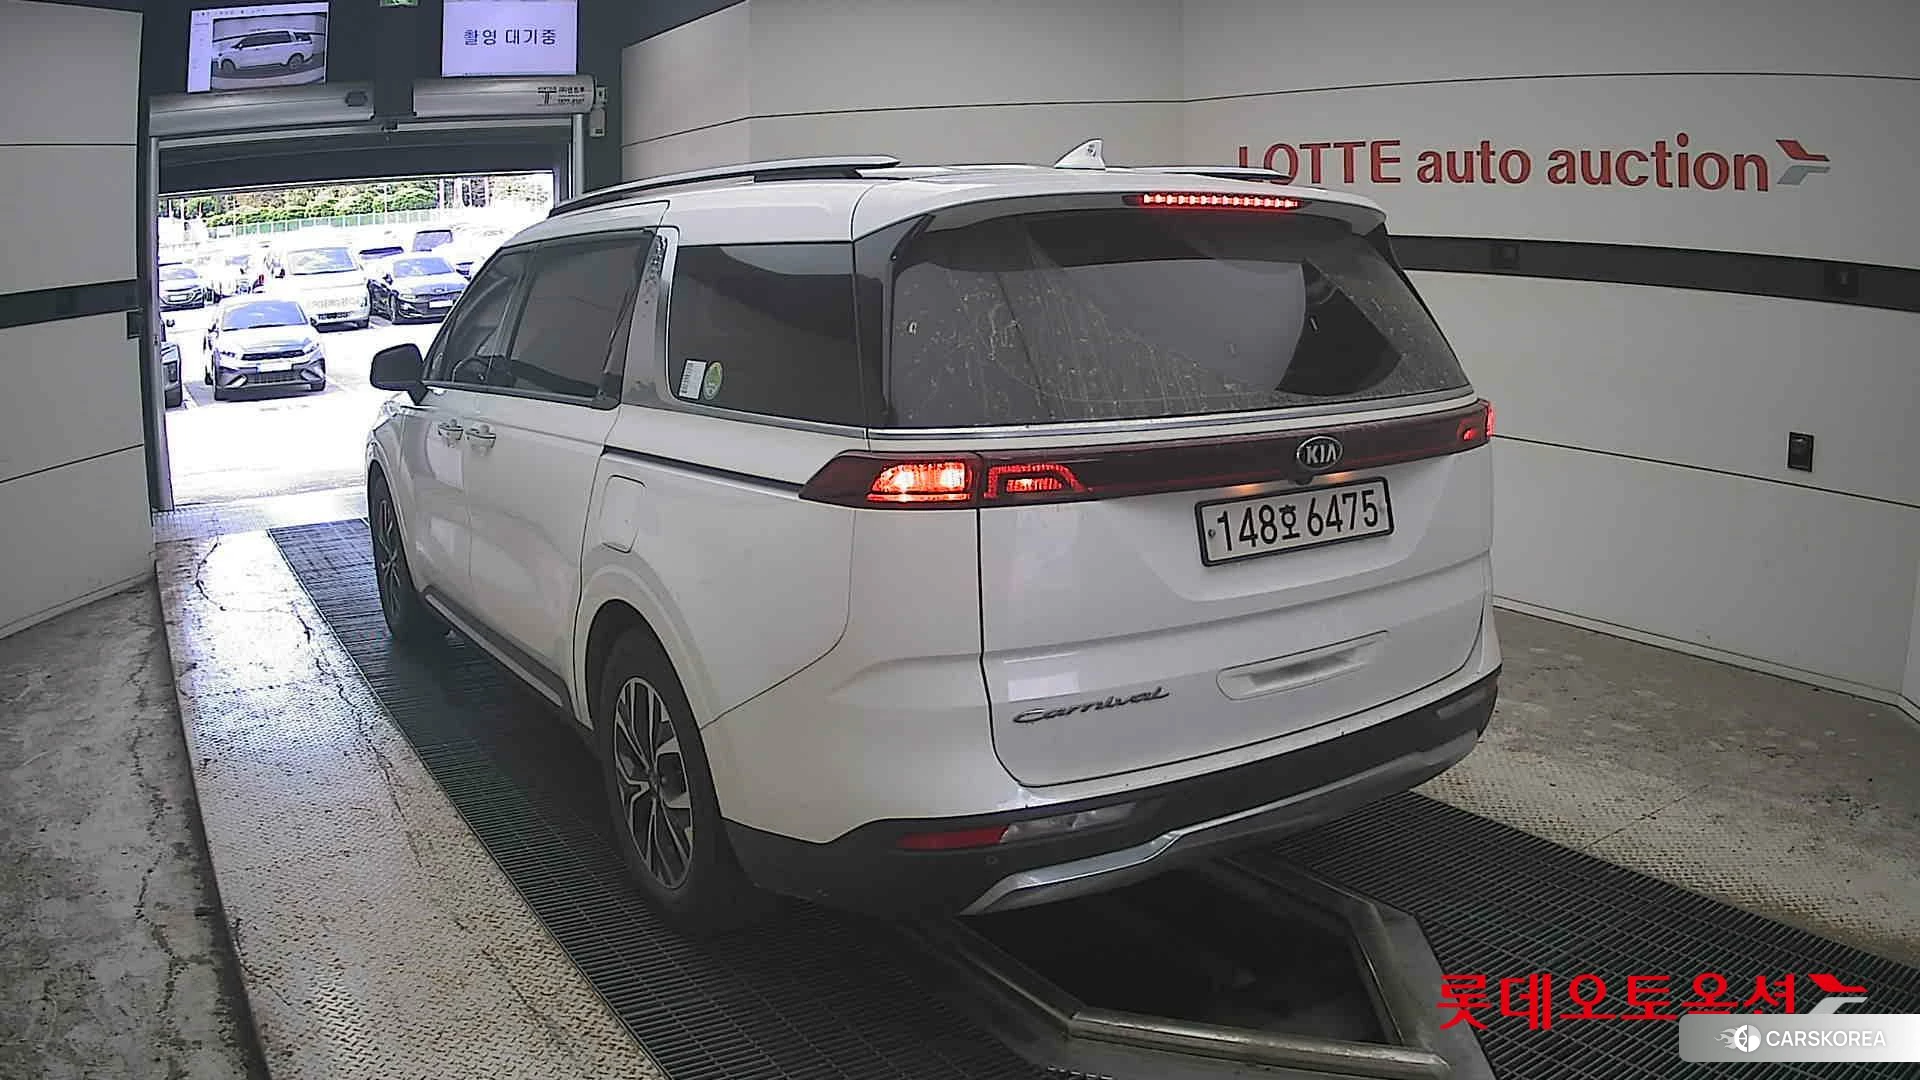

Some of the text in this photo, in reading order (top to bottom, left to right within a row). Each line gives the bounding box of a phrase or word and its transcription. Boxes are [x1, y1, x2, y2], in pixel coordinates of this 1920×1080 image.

[464, 29, 556, 46] 촬영 대기중
[1416, 140, 1531, 185] auto
[1547, 132, 1768, 192] auction
[1013, 686, 1170, 723] Carnival
